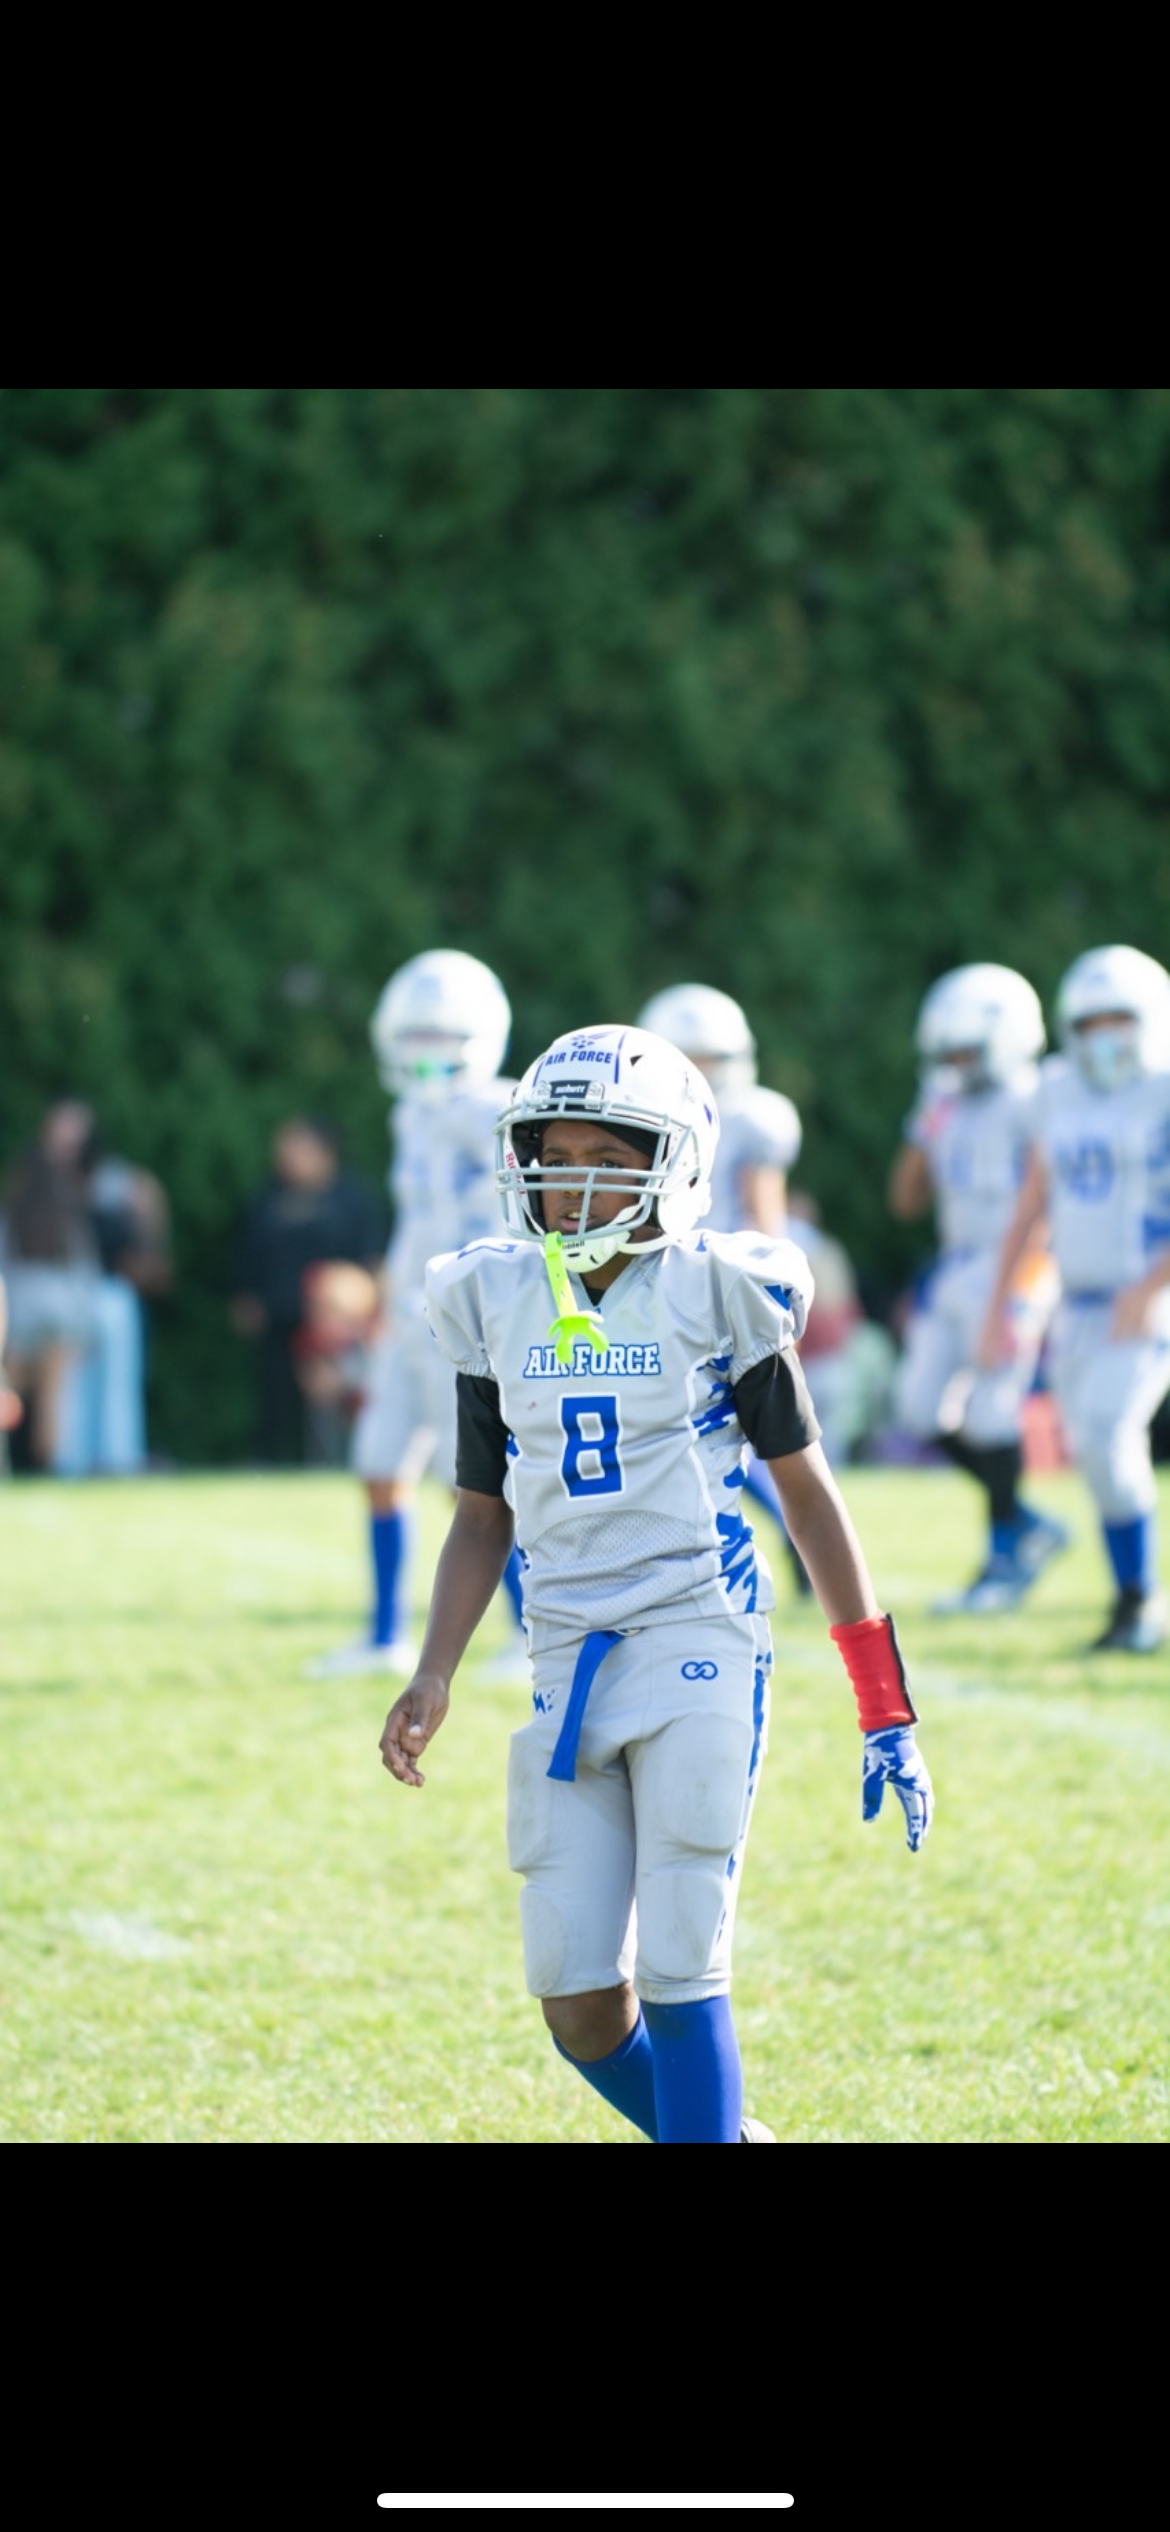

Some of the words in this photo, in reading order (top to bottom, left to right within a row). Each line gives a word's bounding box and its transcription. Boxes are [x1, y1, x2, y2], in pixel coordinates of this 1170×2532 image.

[545, 1052, 567, 1066] AIR
[570, 1050, 613, 1064] FORCE
[572, 1342, 661, 1377] FORCE
[559, 1393, 626, 1500] 8
